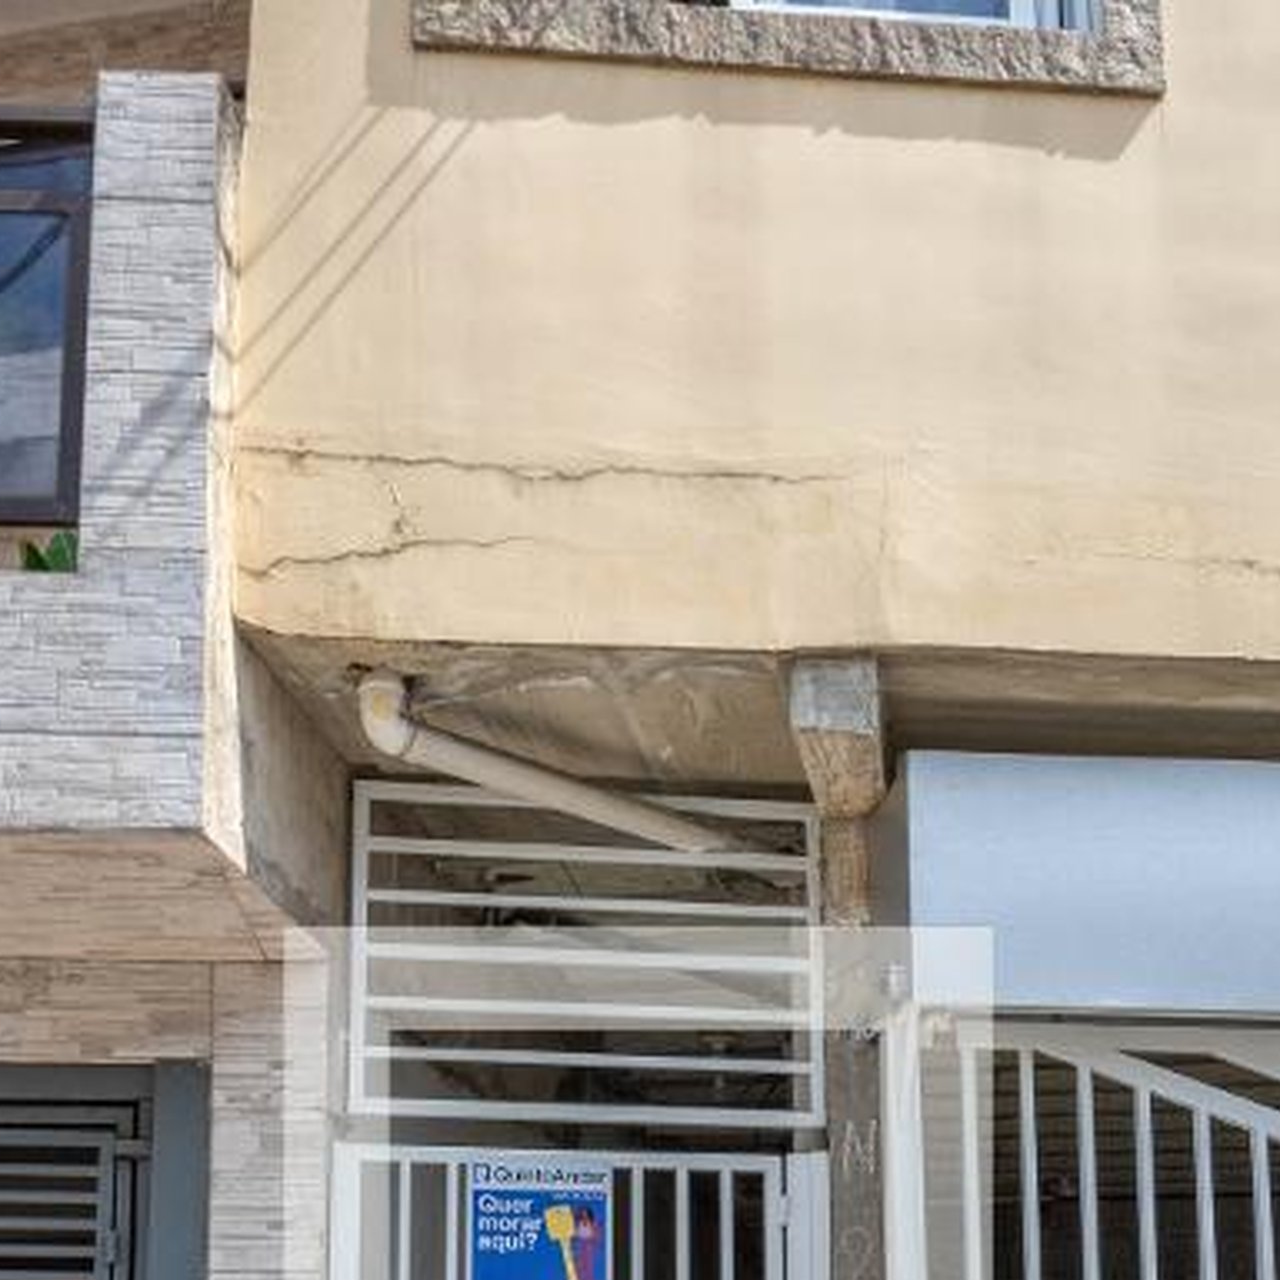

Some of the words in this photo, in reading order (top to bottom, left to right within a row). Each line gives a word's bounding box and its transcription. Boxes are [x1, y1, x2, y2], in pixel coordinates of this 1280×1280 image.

[478, 1193, 534, 1214] Quer
[478, 1216, 542, 1232] morar
[478, 1232, 538, 1254] aqui?
